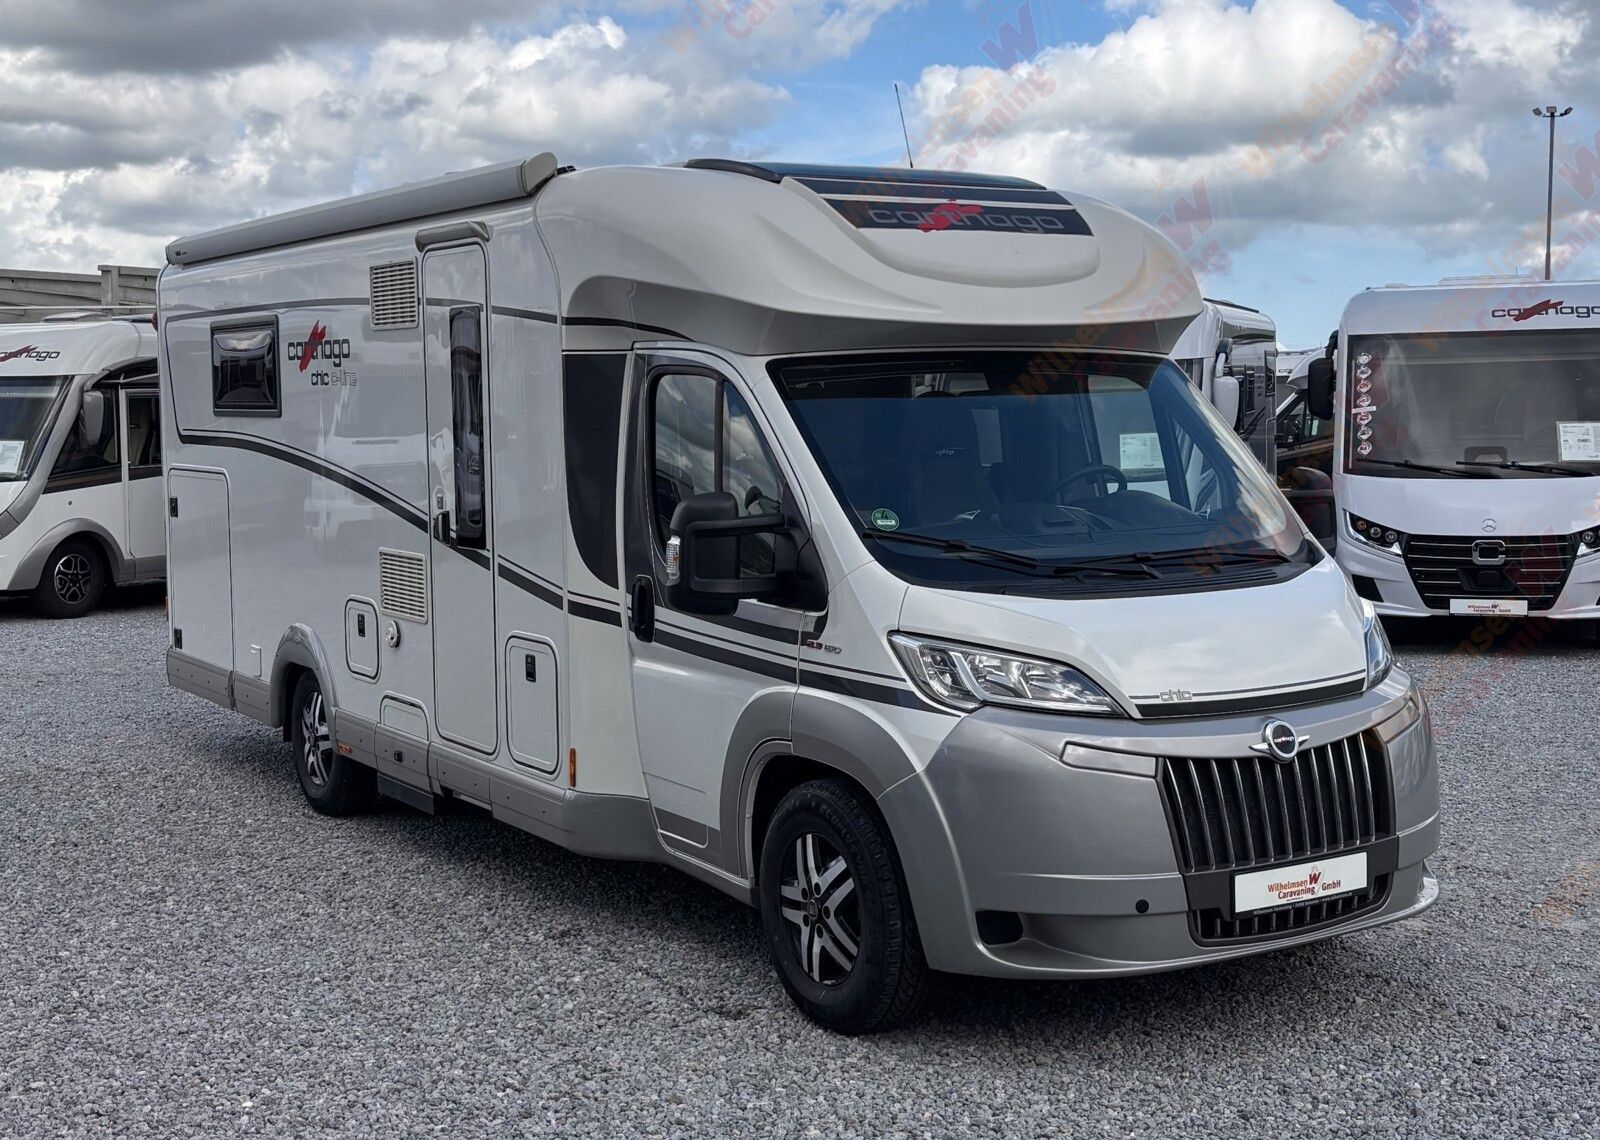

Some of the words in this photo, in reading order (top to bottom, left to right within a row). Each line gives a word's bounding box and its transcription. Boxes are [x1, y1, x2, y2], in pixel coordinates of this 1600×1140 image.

[1491, 301, 1600, 320] cahago
[288, 336, 350, 368] cahago
[1159, 689, 1193, 702] chic
[1267, 879, 1308, 893] Wilhelmsen
[1308, 871, 1322, 885] W
[1278, 886, 1316, 900] Caravaning
[1321, 880, 1341, 891] GmbH
